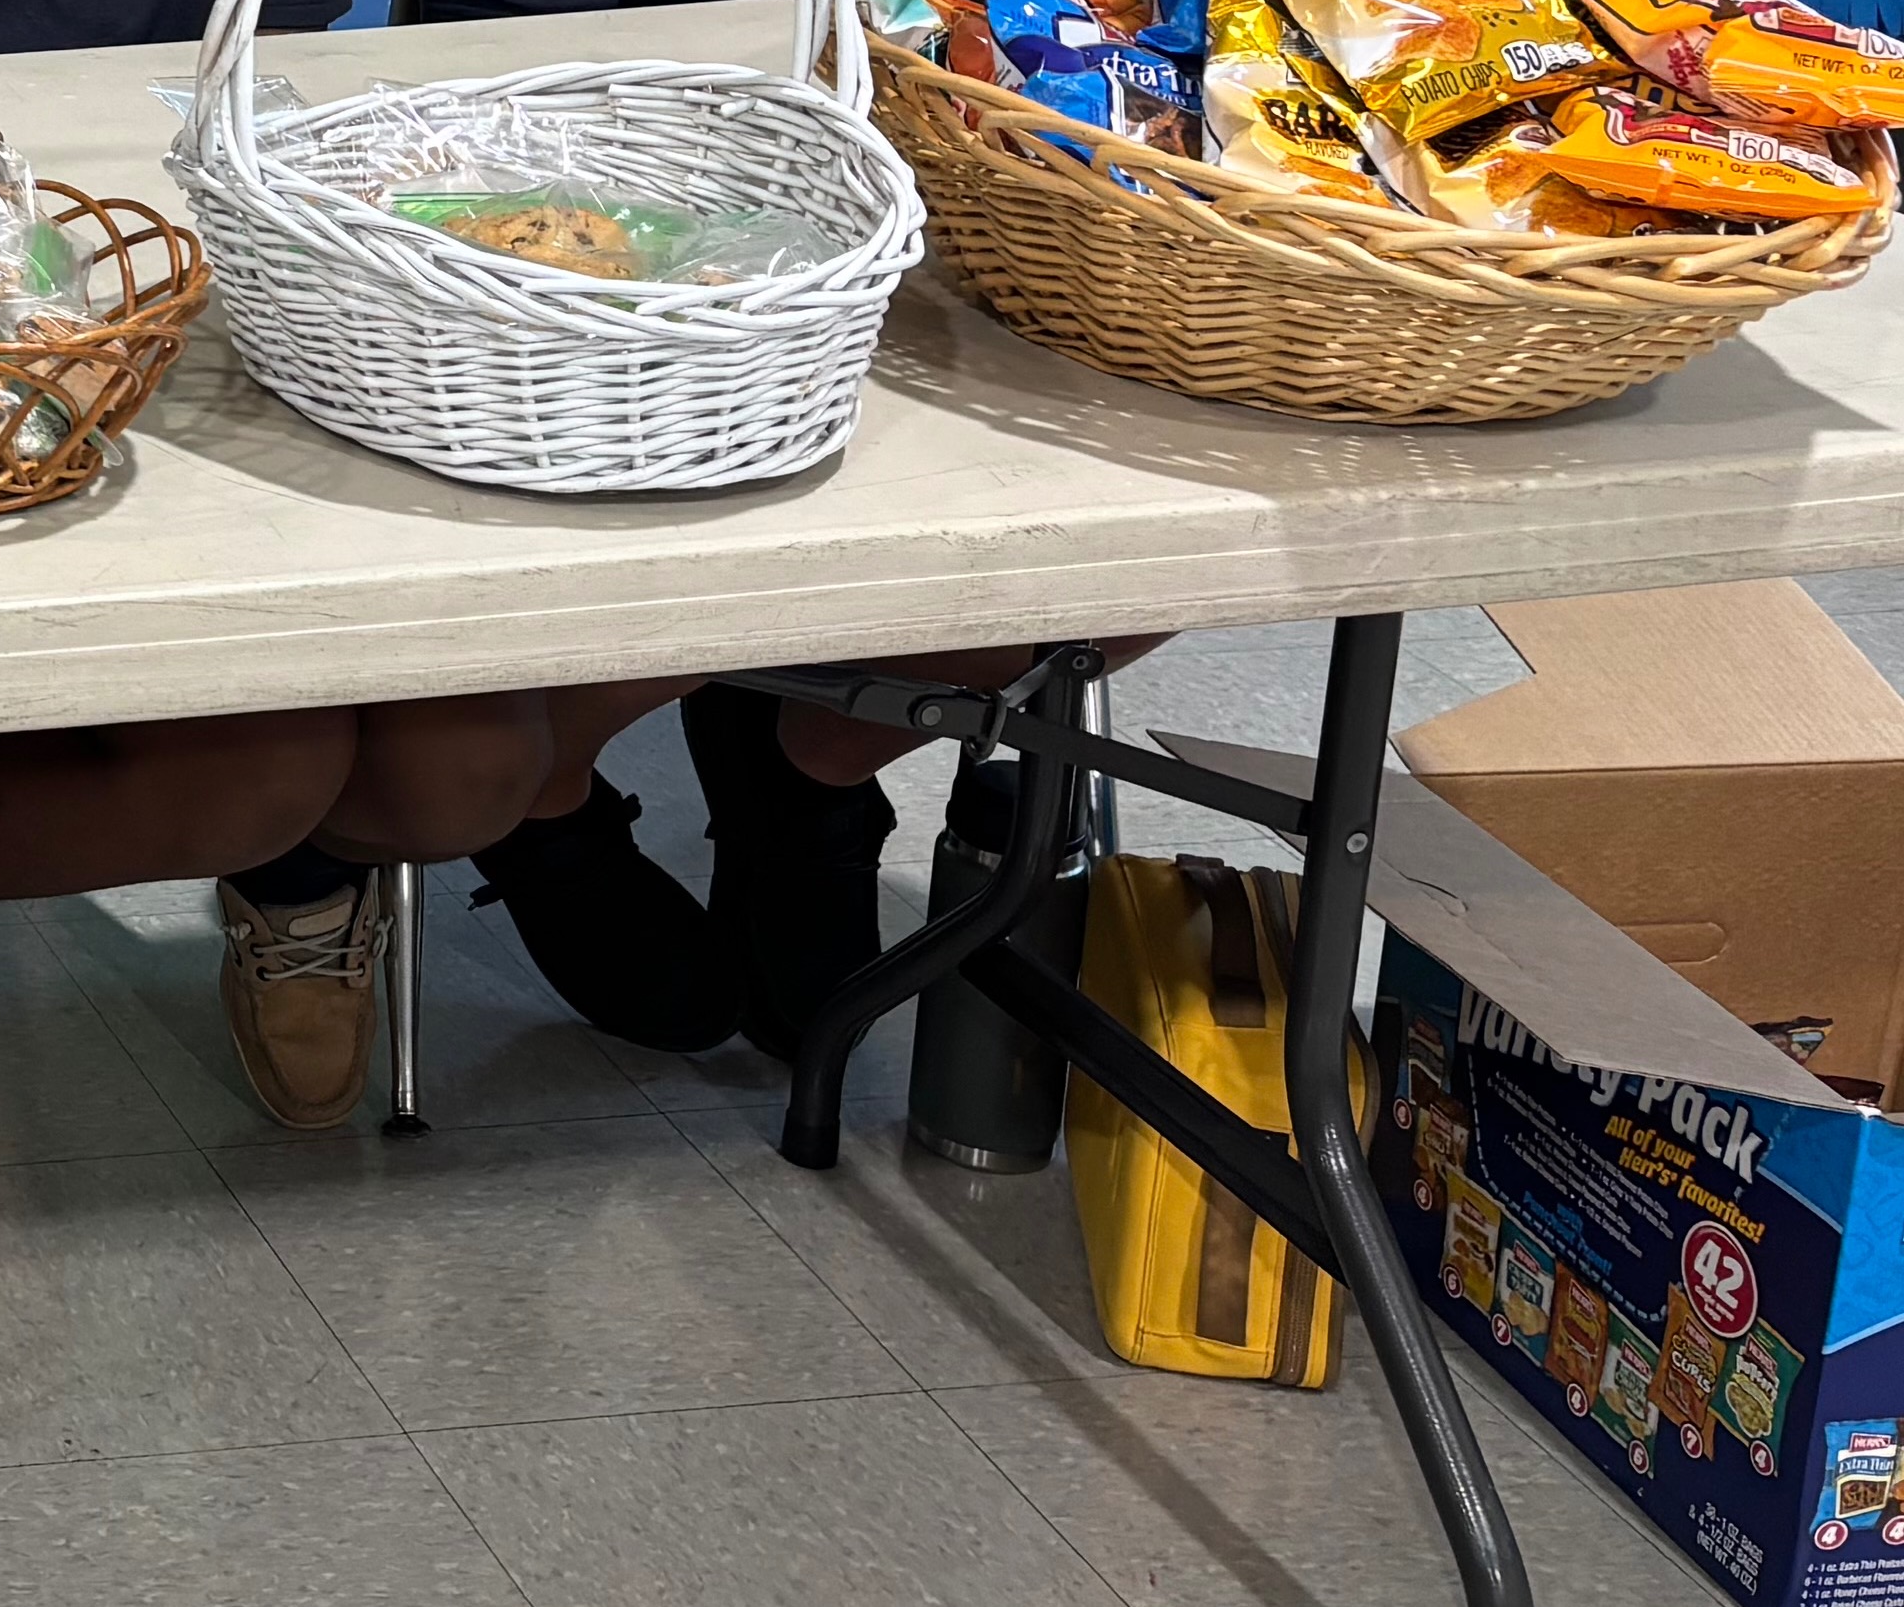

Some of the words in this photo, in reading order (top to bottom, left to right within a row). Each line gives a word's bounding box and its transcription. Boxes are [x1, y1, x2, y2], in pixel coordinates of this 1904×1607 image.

[1503, 43, 1542, 76] 150
[1400, 70, 1461, 108] POTATO
[1461, 60, 1503, 92] CHIPS
[1651, 147, 1680, 159] NET
[1731, 136, 1773, 161] 160
[1604, 1115, 1633, 1142] All
[1632, 1128, 1657, 1153] of
[1650, 1138, 1697, 1171] your
[1636, 1076, 1764, 1185] Pack
[1677, 1175, 1767, 1244] favorites!
[1693, 1238, 1745, 1310] 42
[1822, 1525, 1838, 1544] 4
[1888, 1521, 1904, 1540] 4
